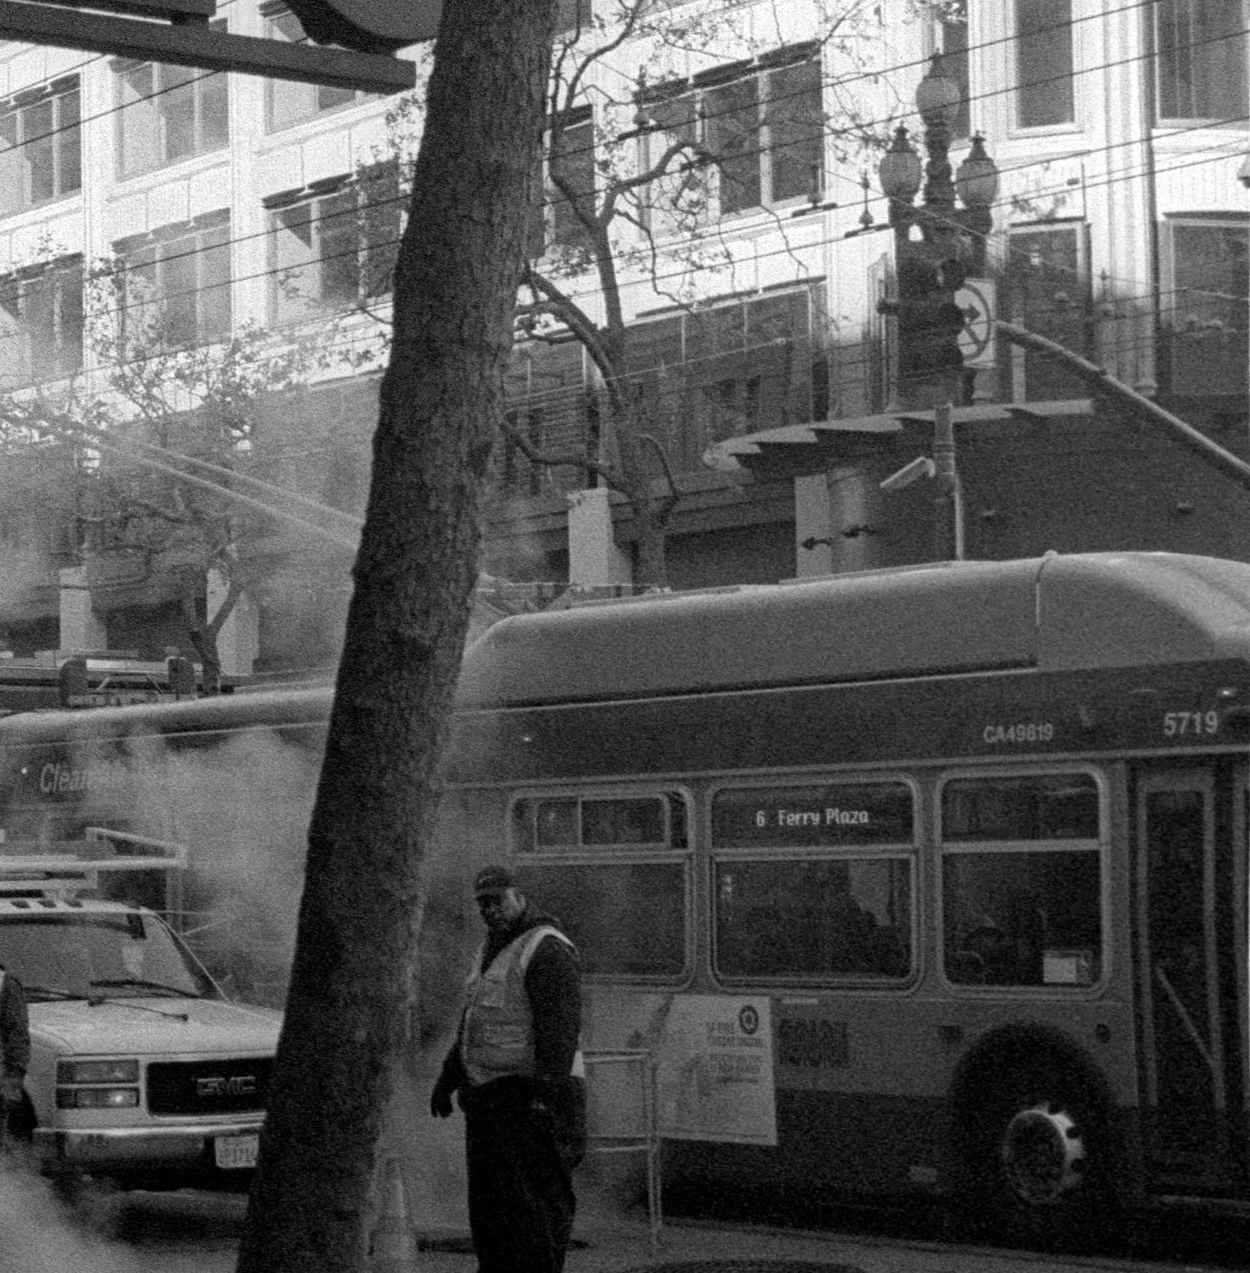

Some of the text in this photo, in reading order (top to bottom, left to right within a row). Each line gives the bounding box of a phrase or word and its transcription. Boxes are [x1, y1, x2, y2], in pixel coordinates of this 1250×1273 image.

[1163, 710, 1219, 736] 5719
[755, 807, 869, 827] 6 Ferry Plaza
[197, 1075, 256, 1096] GMC
